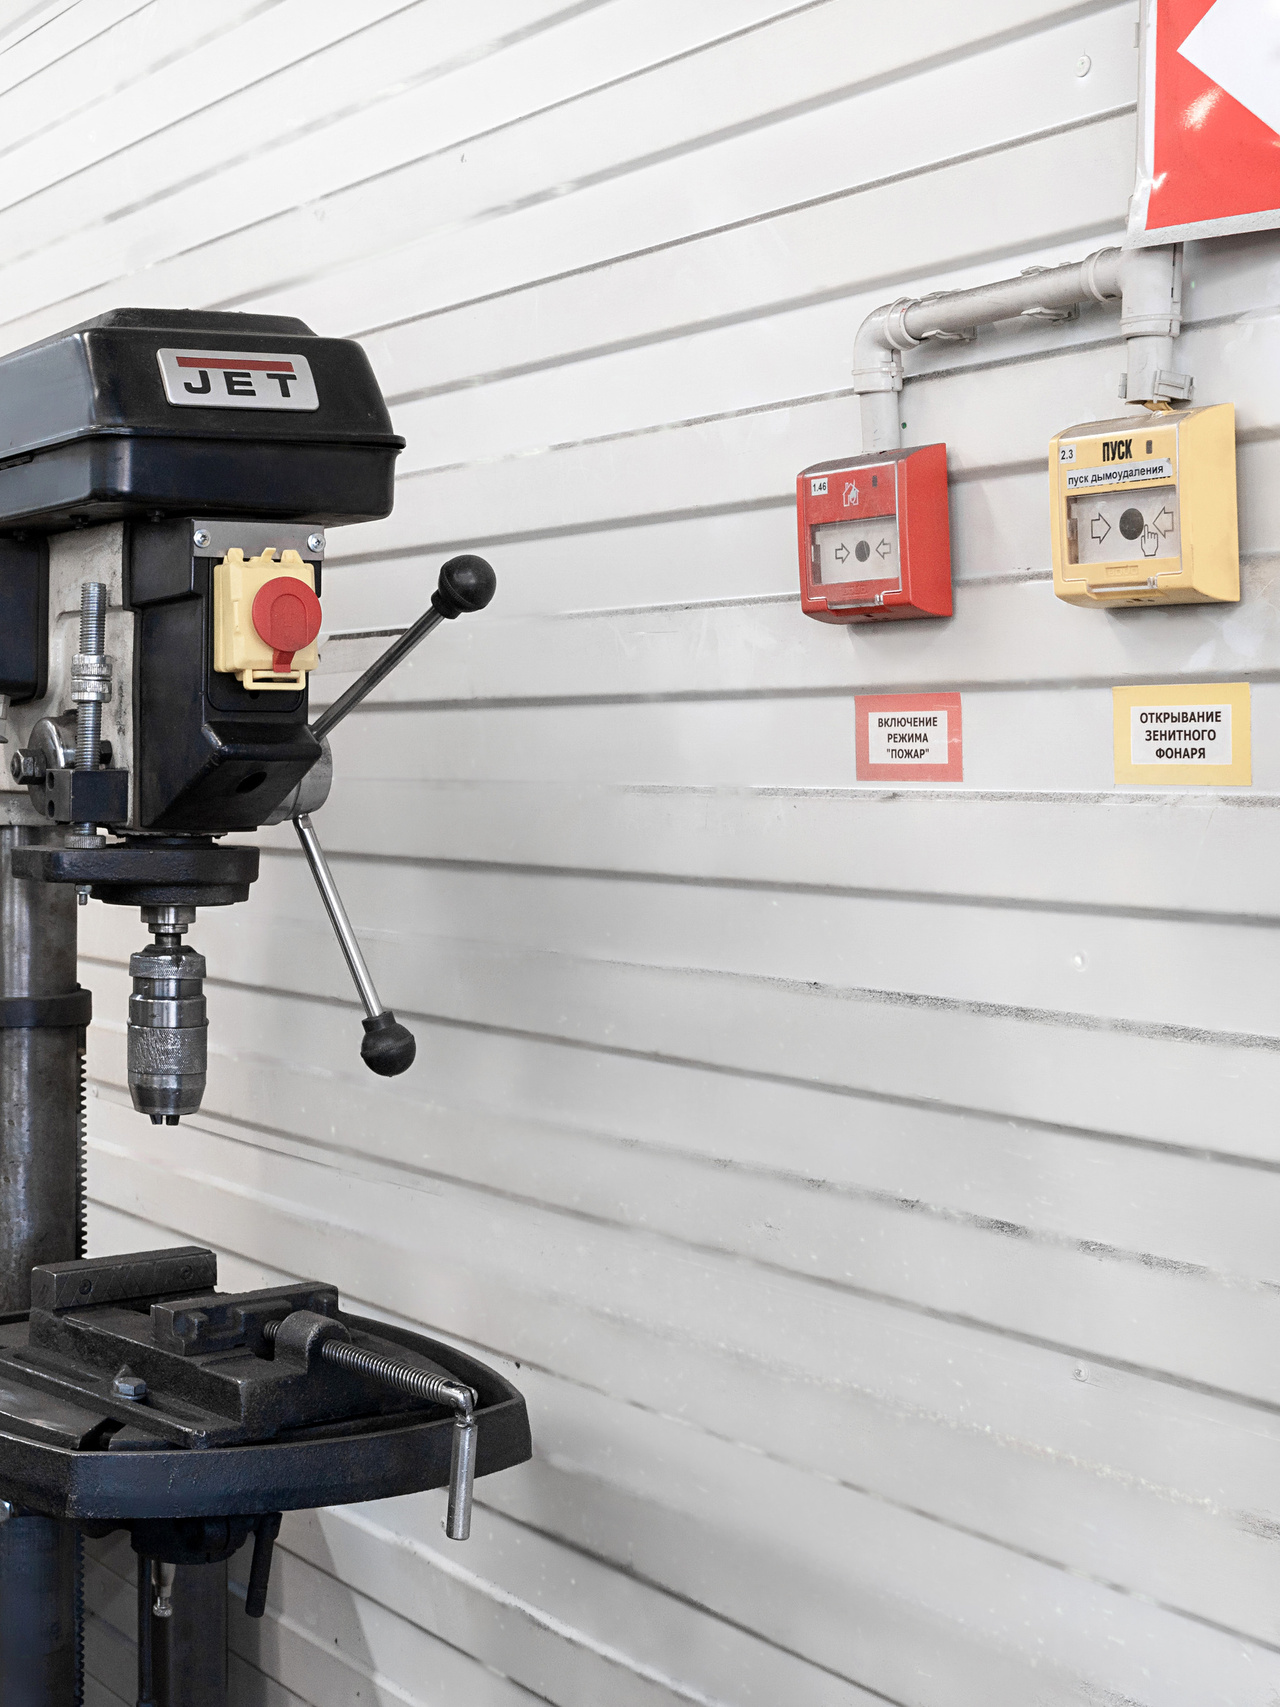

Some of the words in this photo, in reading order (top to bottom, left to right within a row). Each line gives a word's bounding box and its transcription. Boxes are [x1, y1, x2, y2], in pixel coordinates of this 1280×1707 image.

[183, 369, 298, 398] JET
[1060, 449, 1074, 460] 2.3
[1102, 438, 1133, 462] ПУСК
[1068, 475, 1089, 486] пуск
[1090, 465, 1164, 484] дымоудаления
[812, 482, 827, 492] 1.46
[877, 717, 938, 728] ВКЛЮЧЕНИЕ
[1139, 711, 1222, 724] ОТКРЫВАНИЕ
[887, 733, 929, 743] РЕЖИМА
[1144, 729, 1217, 742] ЗЕНИТНОГО
[886, 748, 930, 759] "ПОЖАР"
[1155, 747, 1206, 760] ФОНАРЯ
